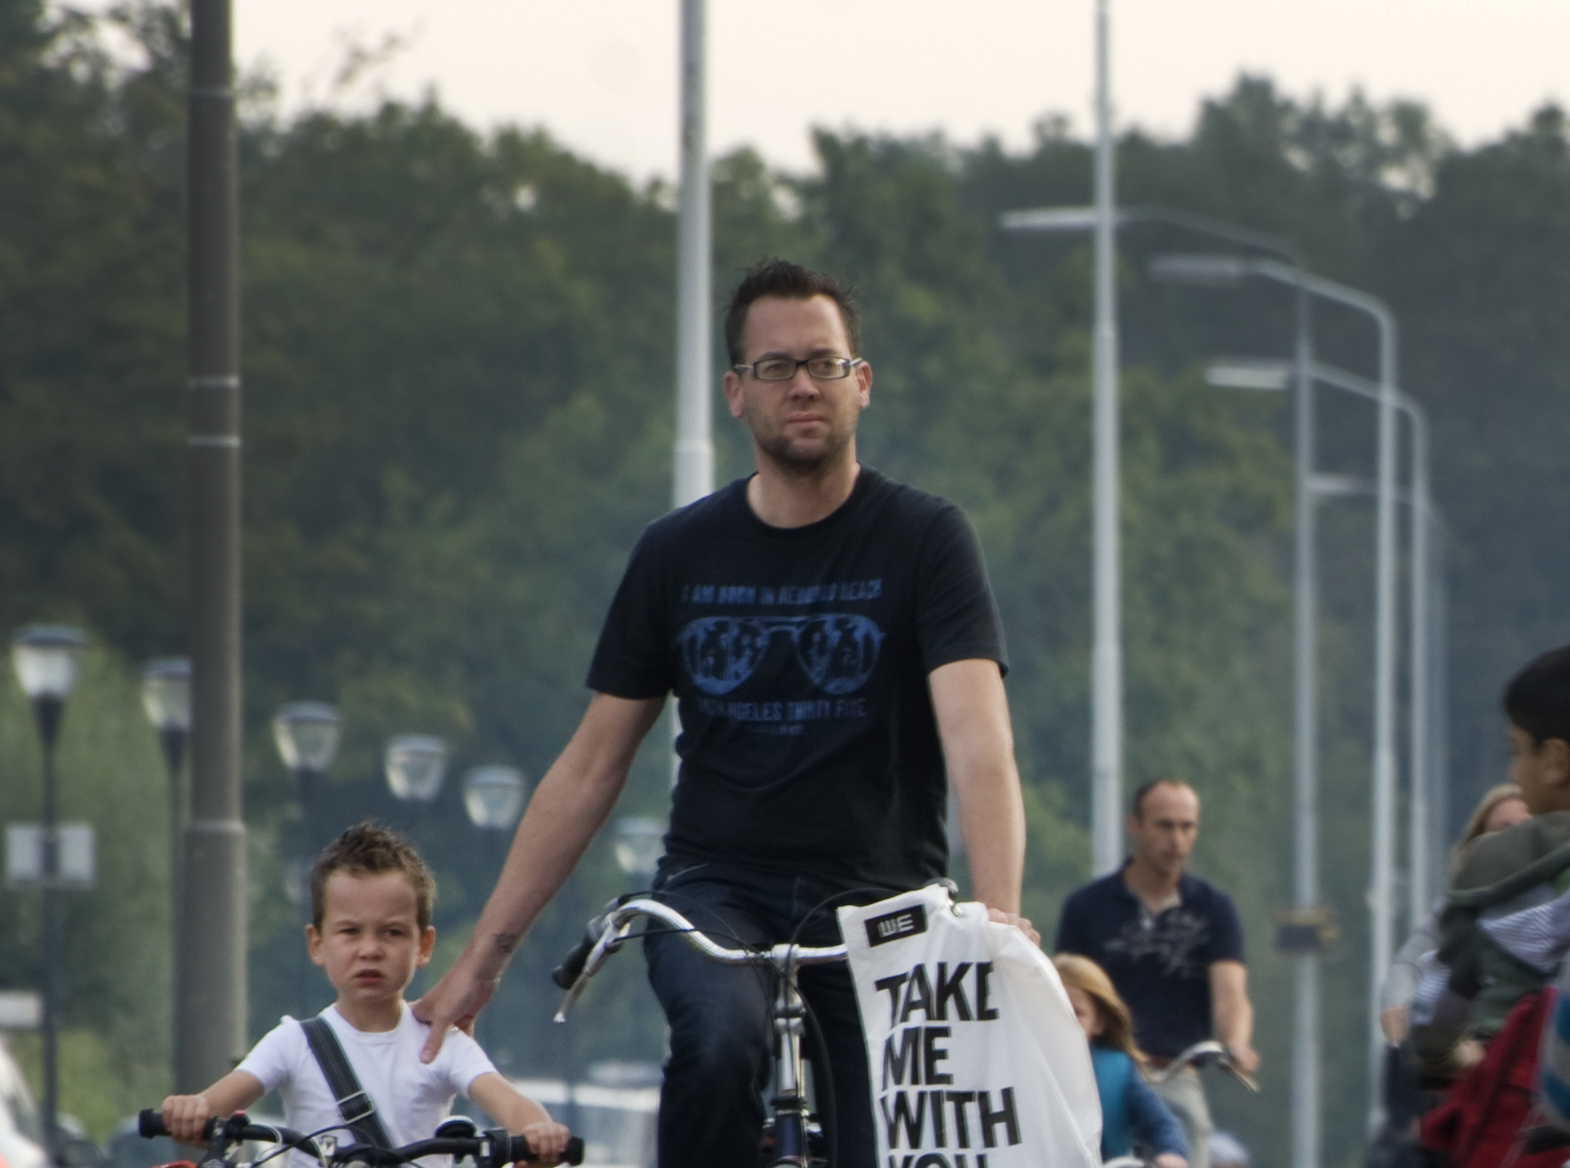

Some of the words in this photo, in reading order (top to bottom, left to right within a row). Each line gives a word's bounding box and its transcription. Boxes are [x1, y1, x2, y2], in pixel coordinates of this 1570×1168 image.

[874, 961, 999, 1026] TAKE
[881, 1026, 954, 1091] ME
[879, 1086, 1023, 1150] WITH
